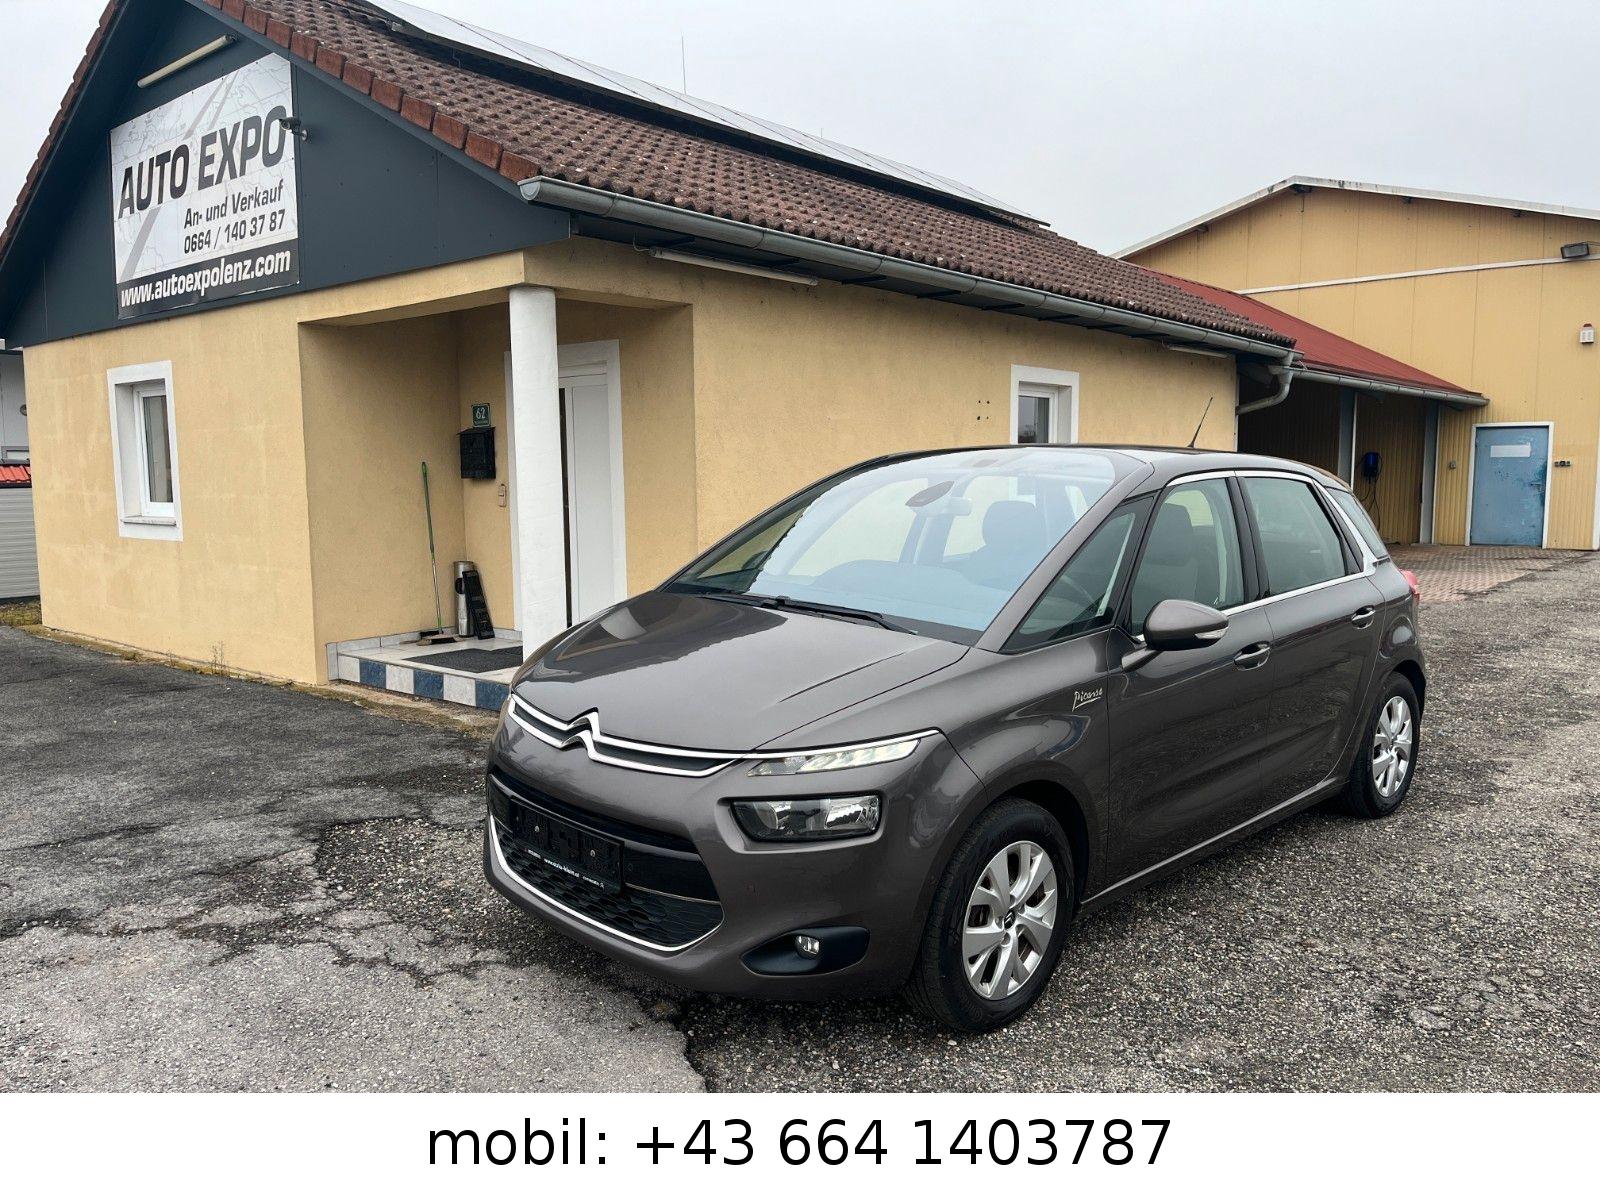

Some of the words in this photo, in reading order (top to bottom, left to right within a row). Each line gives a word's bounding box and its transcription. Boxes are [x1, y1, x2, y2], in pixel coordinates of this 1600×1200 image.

[118, 143, 190, 219] AUTO
[197, 105, 287, 191] EXPO
[183, 207, 203, 229] An-
[206, 194, 228, 221] und
[231, 179, 284, 213] Verkauf
[183, 229, 212, 254] 0664
[224, 225, 247, 243] 140
[249, 216, 266, 236] 37
[269, 209, 286, 231] 87
[121, 250, 291, 308] www.autoexpolenz.com
[475, 407, 486, 419] 62
